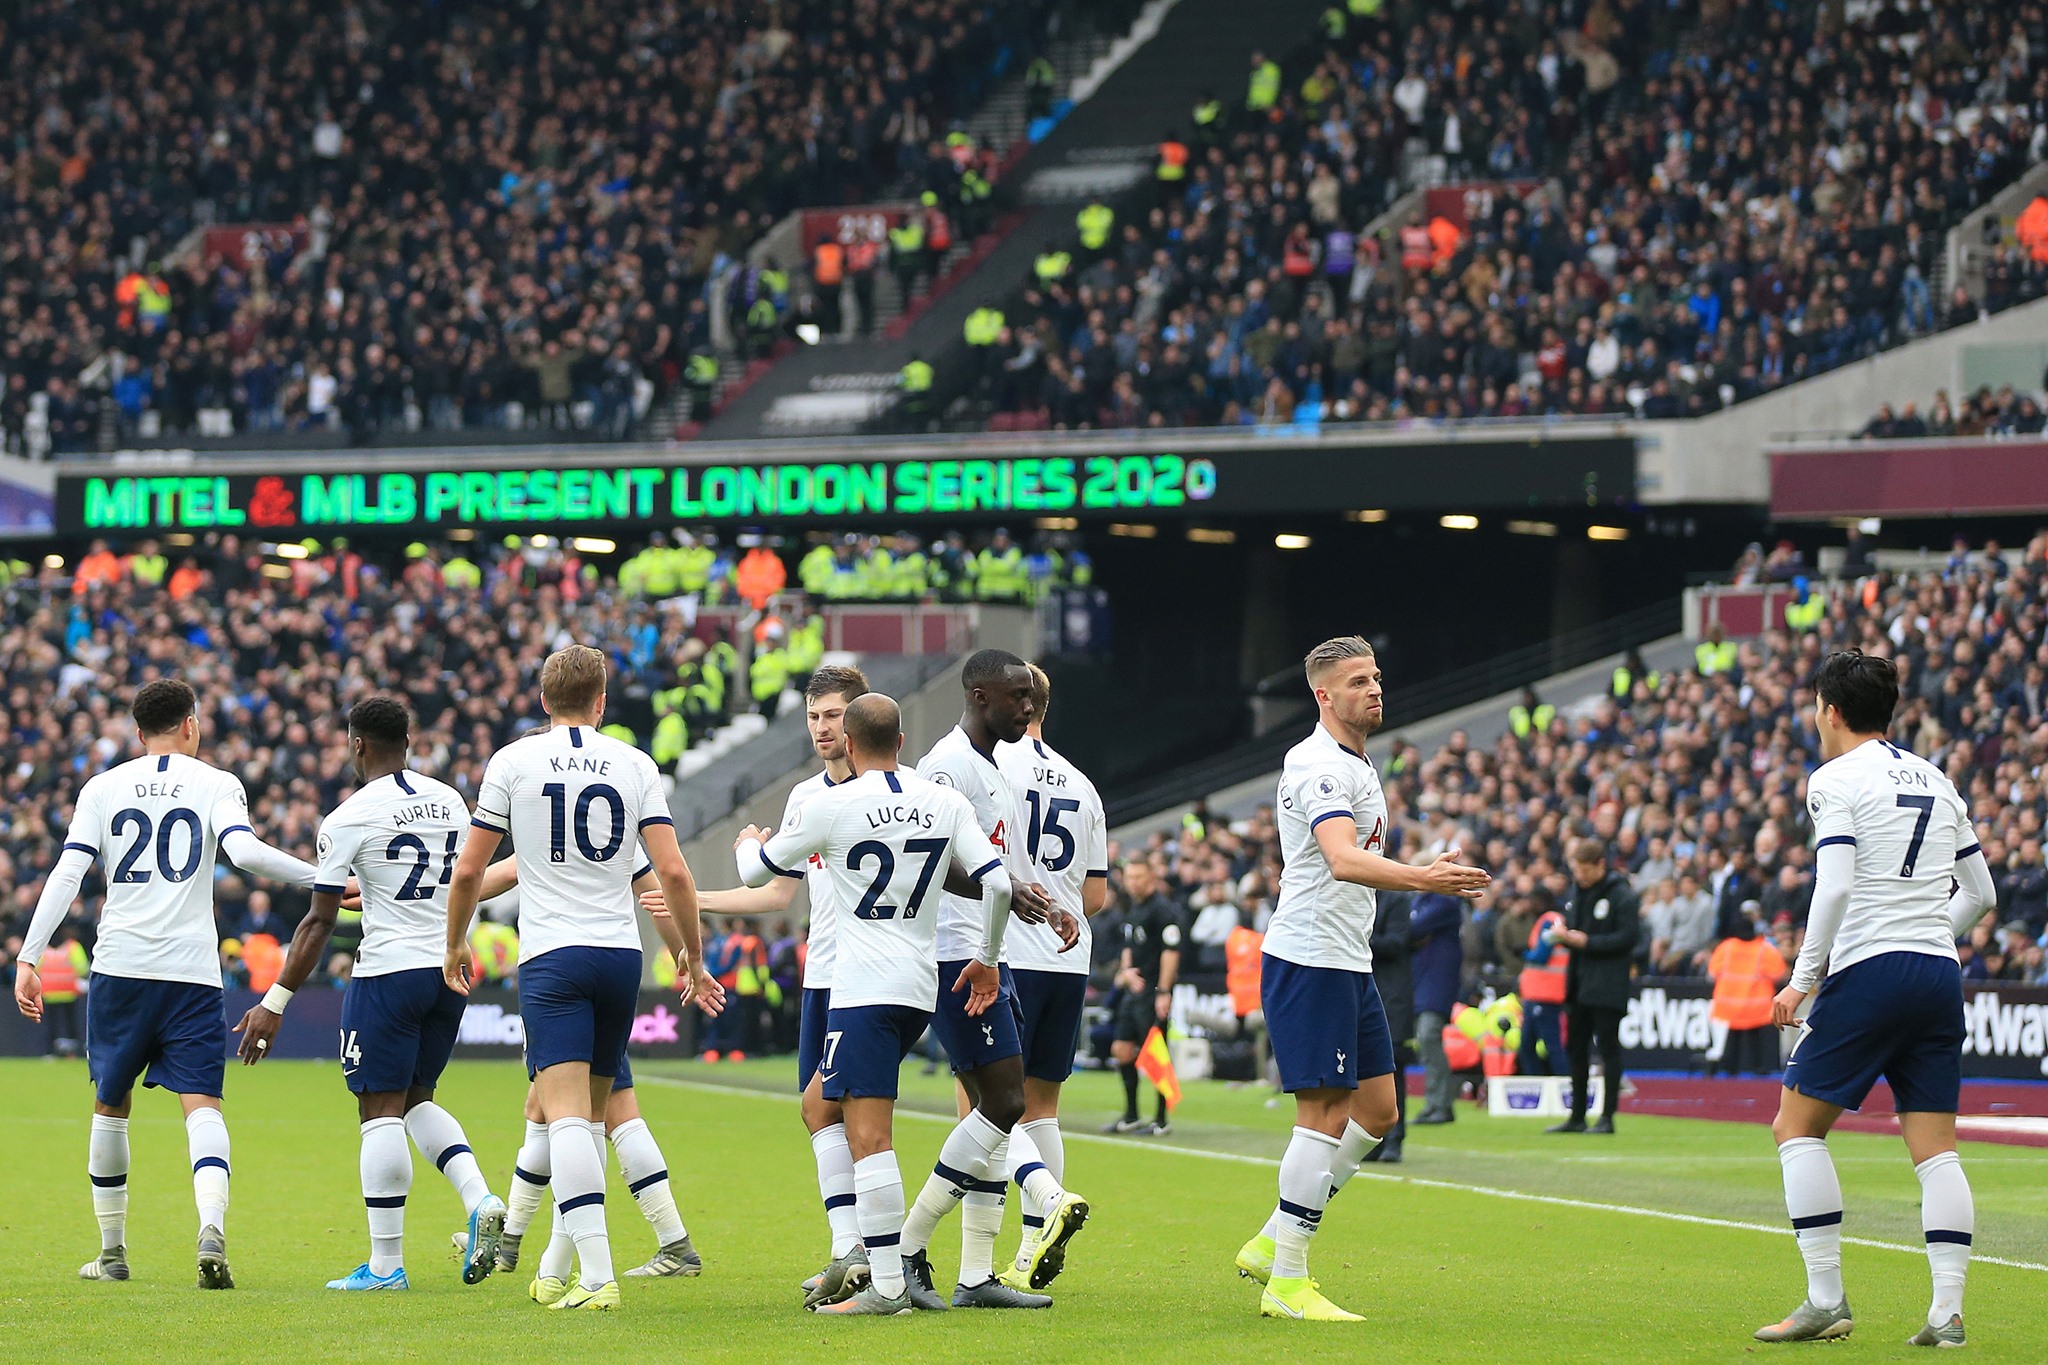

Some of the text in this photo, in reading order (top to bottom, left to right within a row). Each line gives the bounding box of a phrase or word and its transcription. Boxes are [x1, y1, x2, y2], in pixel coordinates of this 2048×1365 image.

[84, 454, 1217, 527] MITEL & MLB PRESENT LONDON SERIES 2020
[135, 783, 183, 798] DELE
[550, 757, 611, 776] KANE
[1888, 770, 1928, 789] SON
[111, 807, 203, 883] 20
[393, 803, 450, 828] AURIER
[541, 783, 625, 862] 10
[866, 806, 935, 829] LUCAS
[1025, 789, 1080, 871] 15
[1896, 794, 1935, 878] 7
[847, 838, 950, 919] 27
[1618, 988, 1731, 1061] etway
